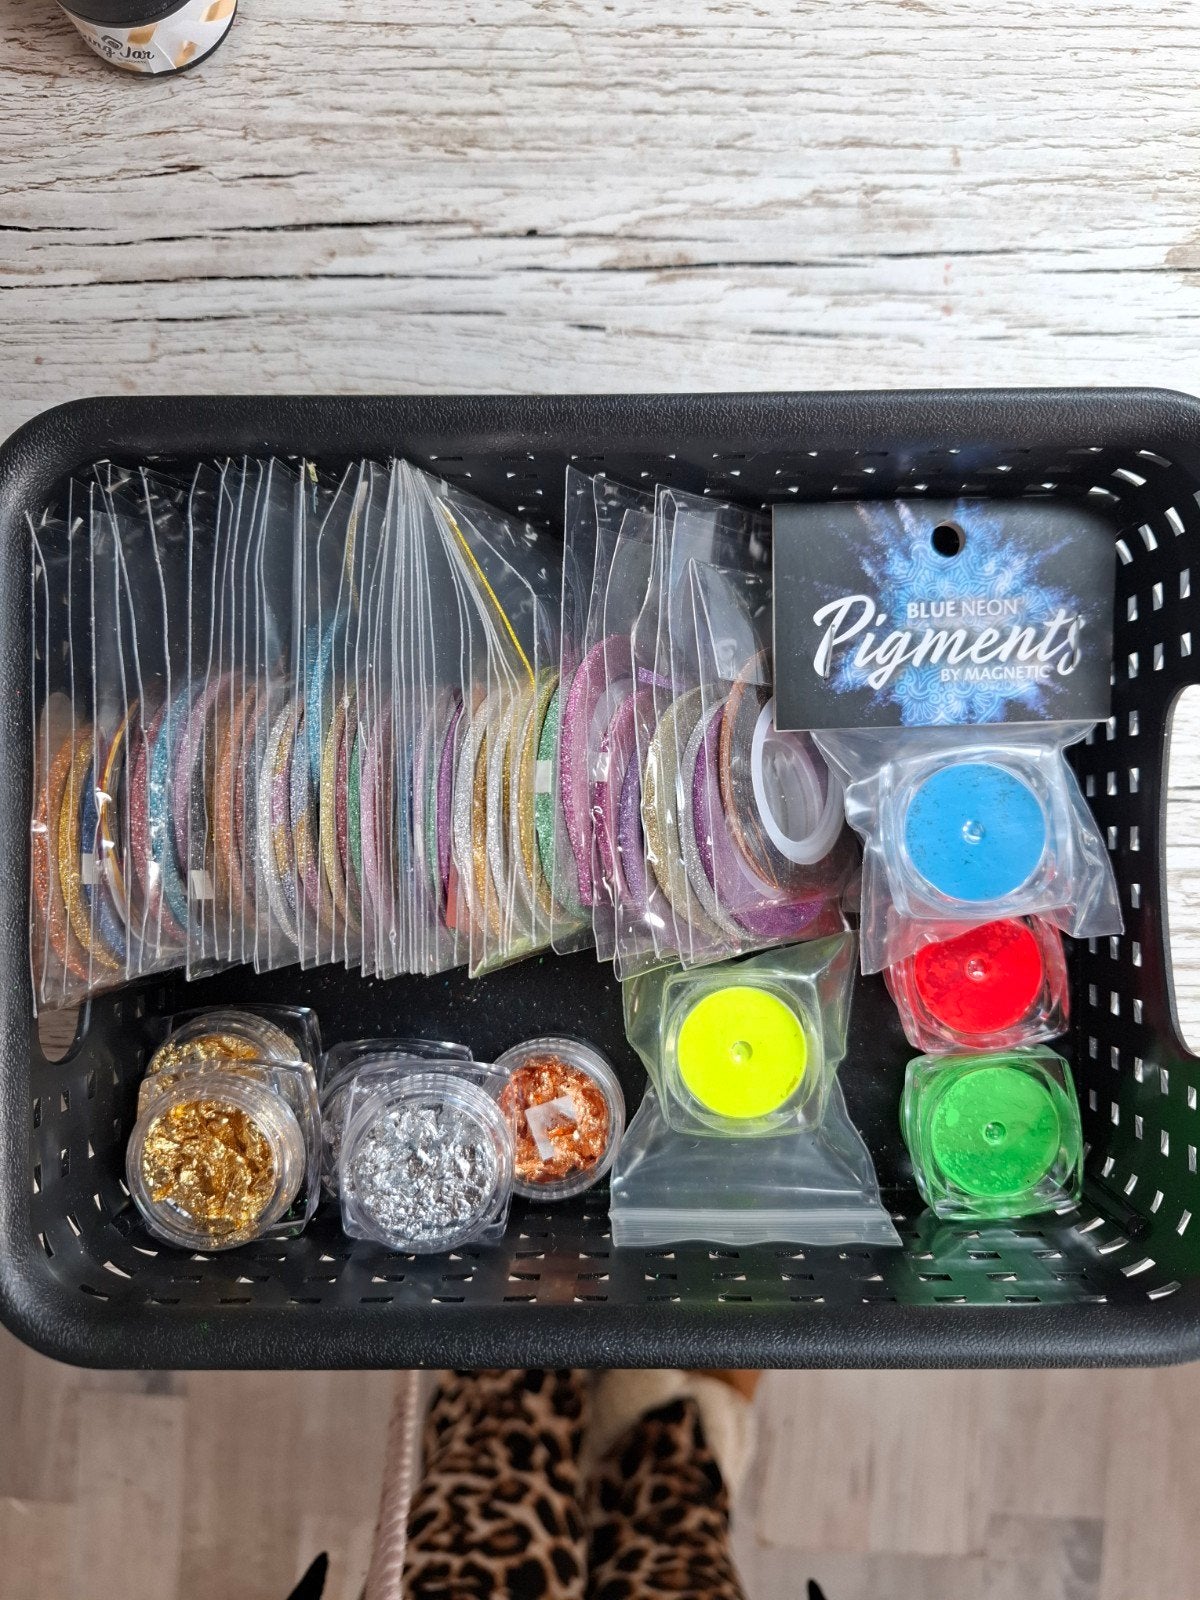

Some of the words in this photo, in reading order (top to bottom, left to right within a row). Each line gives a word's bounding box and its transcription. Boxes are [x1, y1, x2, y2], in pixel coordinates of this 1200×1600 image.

[119, 46, 155, 60] Jar
[906, 601, 956, 619] BLUE
[961, 600, 1018, 617] NEON
[812, 595, 1087, 691] Pigments
[940, 668, 961, 682] BY
[964, 665, 1051, 681] MAGNETIC
